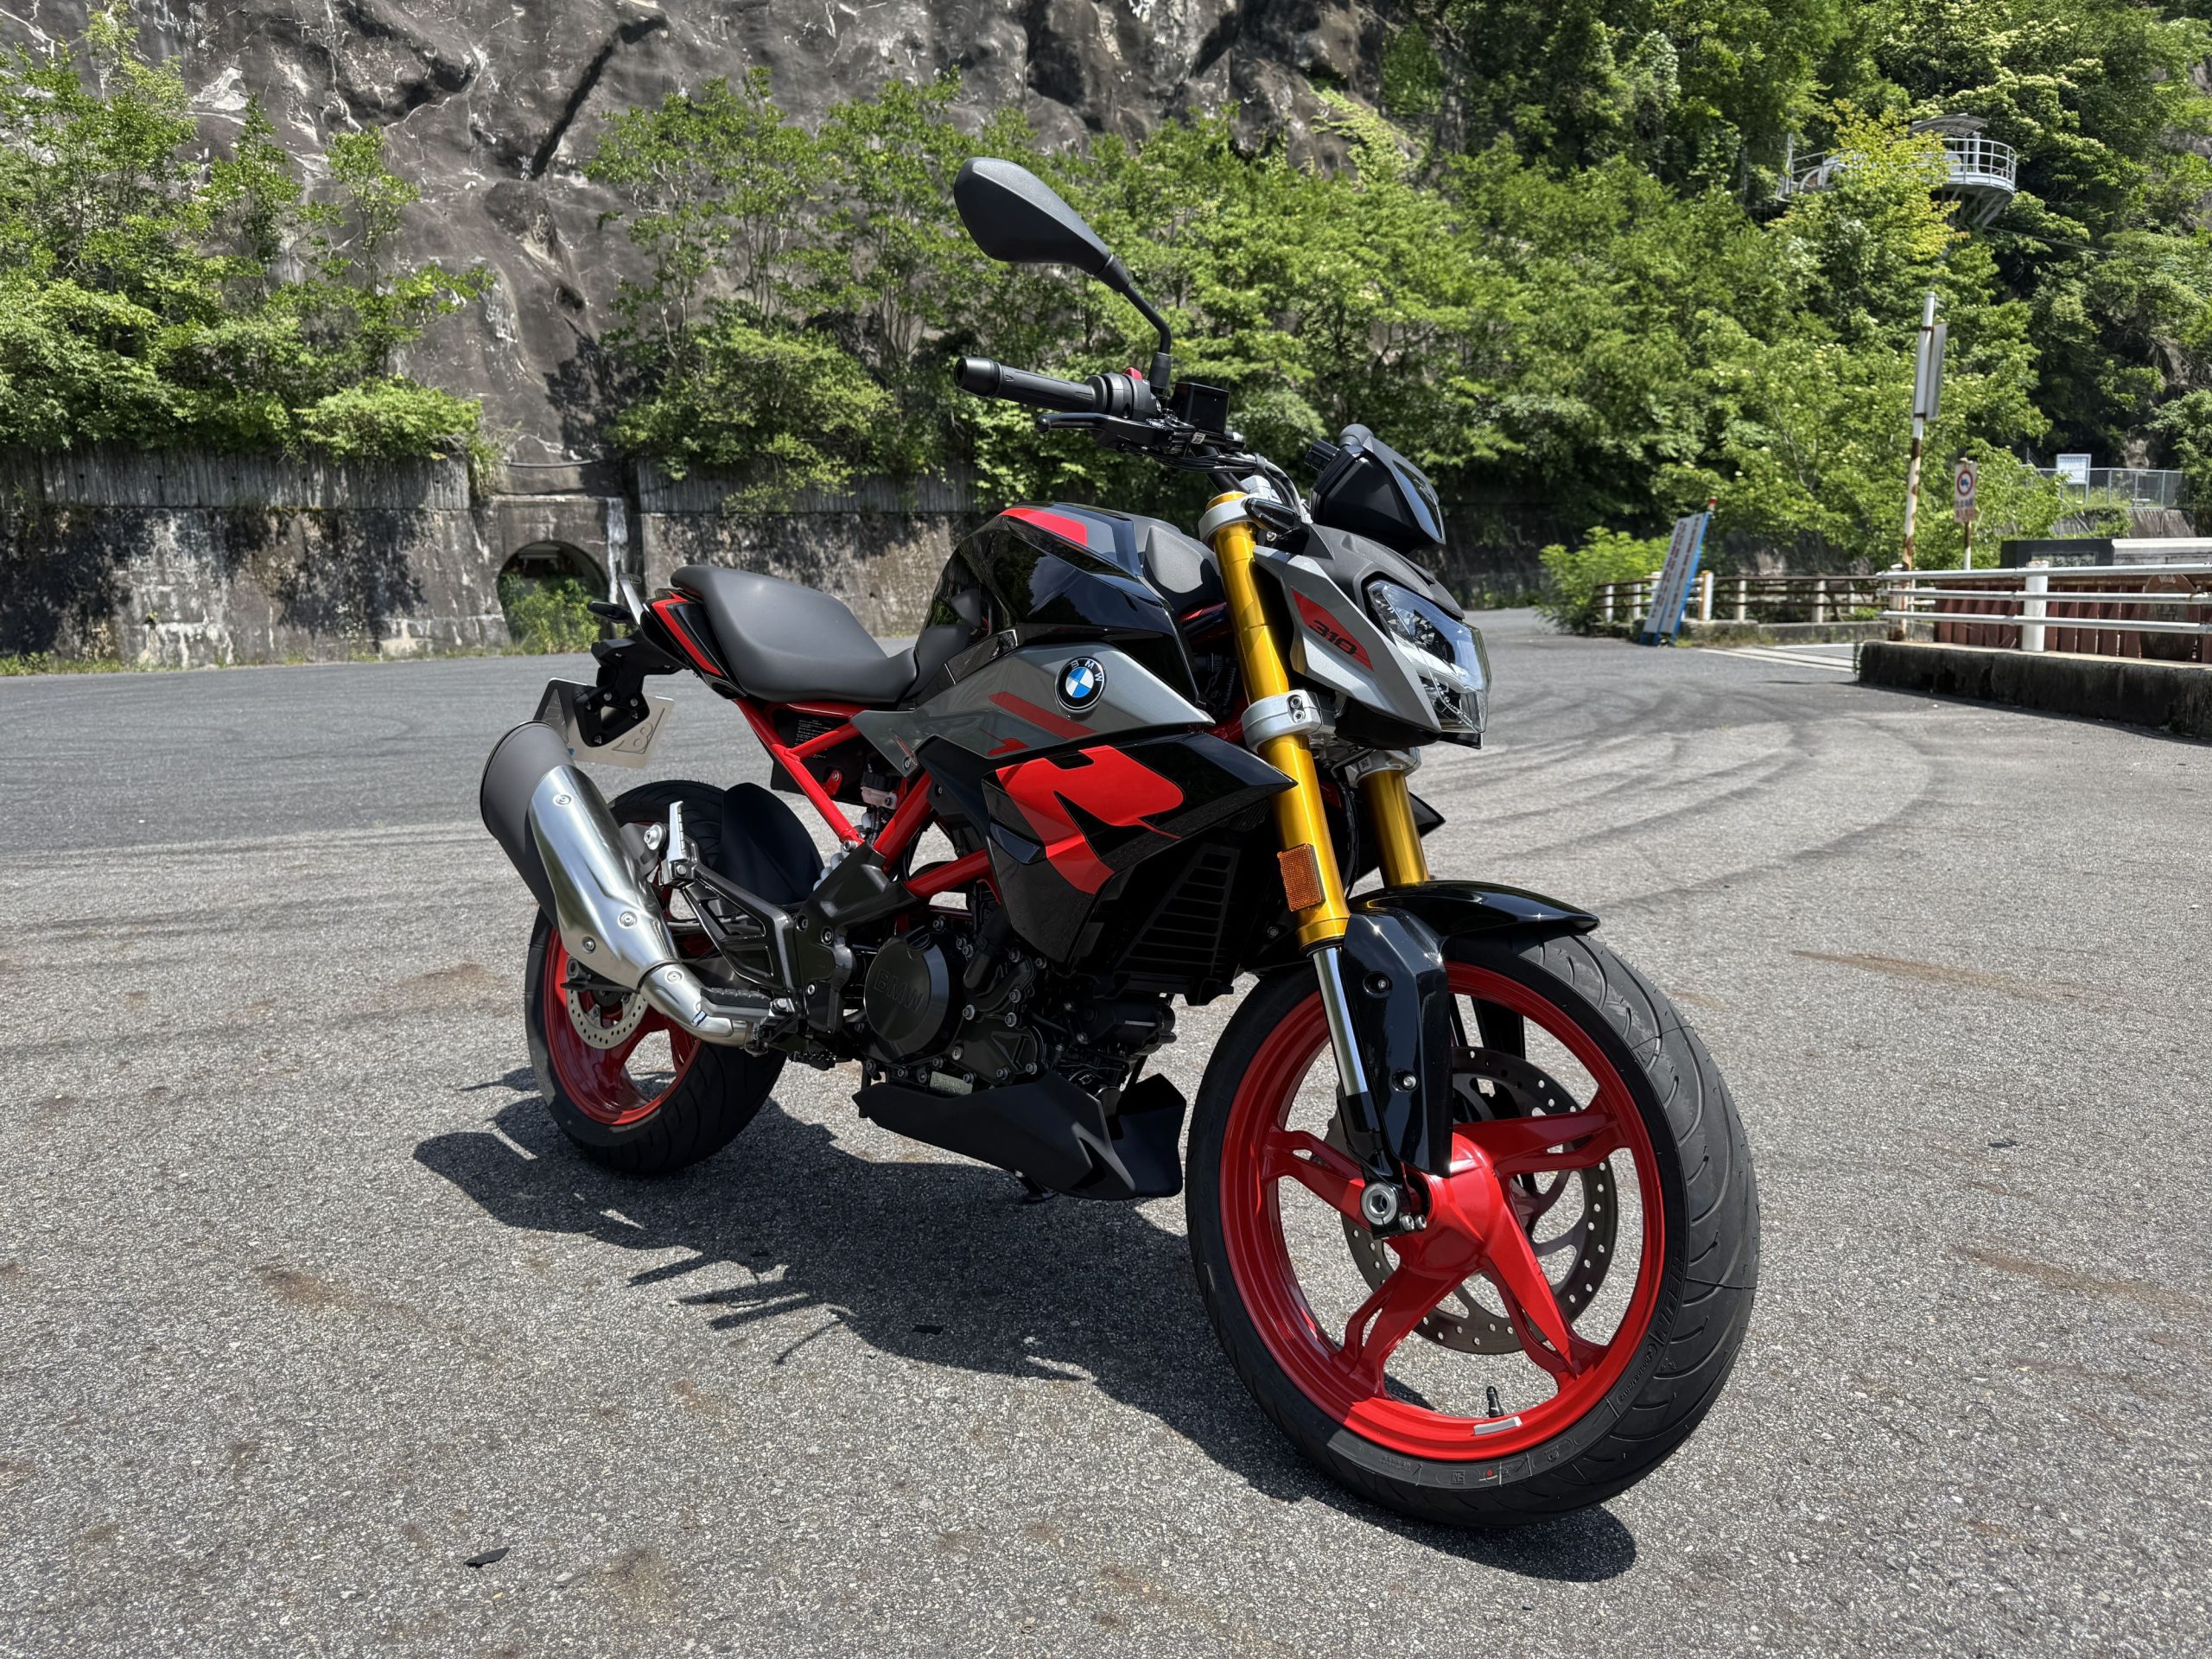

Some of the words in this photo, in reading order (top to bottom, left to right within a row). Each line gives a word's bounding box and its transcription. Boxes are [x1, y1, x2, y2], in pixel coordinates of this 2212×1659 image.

[1308, 620, 1357, 655] 310
[1071, 658, 1103, 682] BMW
[874, 969, 925, 1013] BMW
